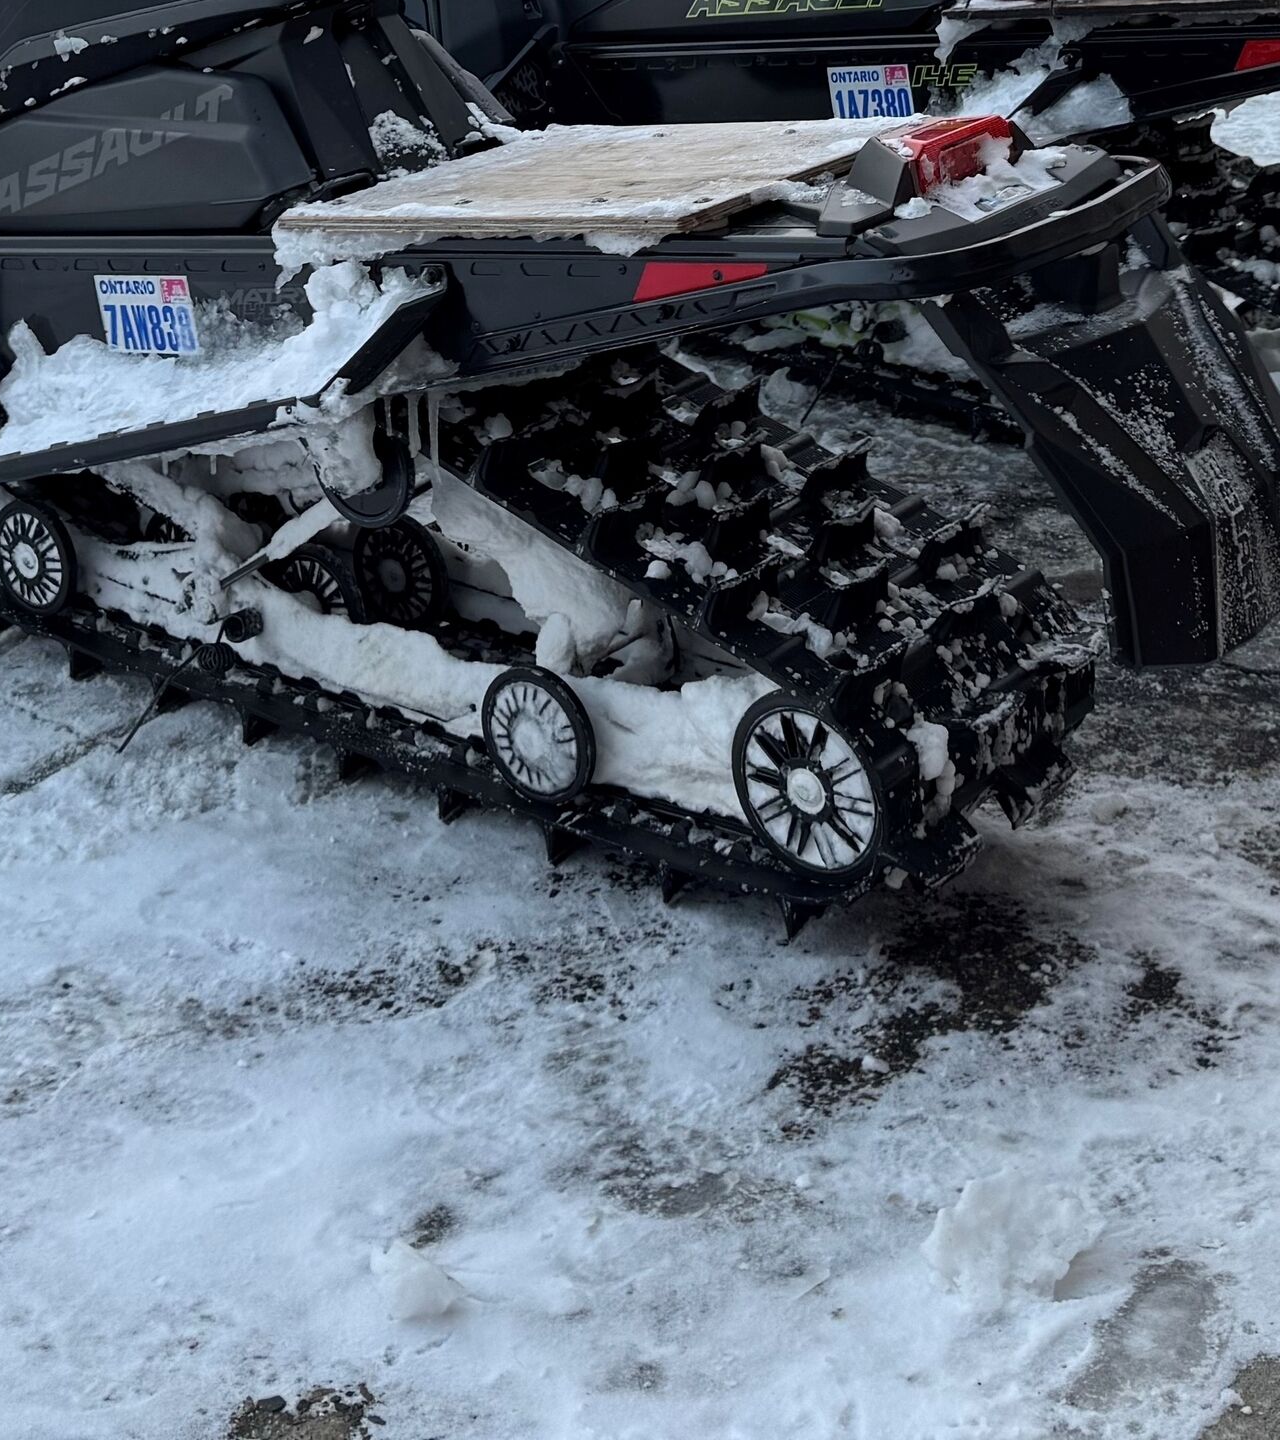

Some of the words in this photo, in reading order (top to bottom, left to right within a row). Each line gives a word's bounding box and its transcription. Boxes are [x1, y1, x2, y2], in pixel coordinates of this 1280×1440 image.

[830, 70, 880, 84] ONTARIO
[835, 88, 912, 119] 1A7380
[99, 279, 155, 295] ONTARIO
